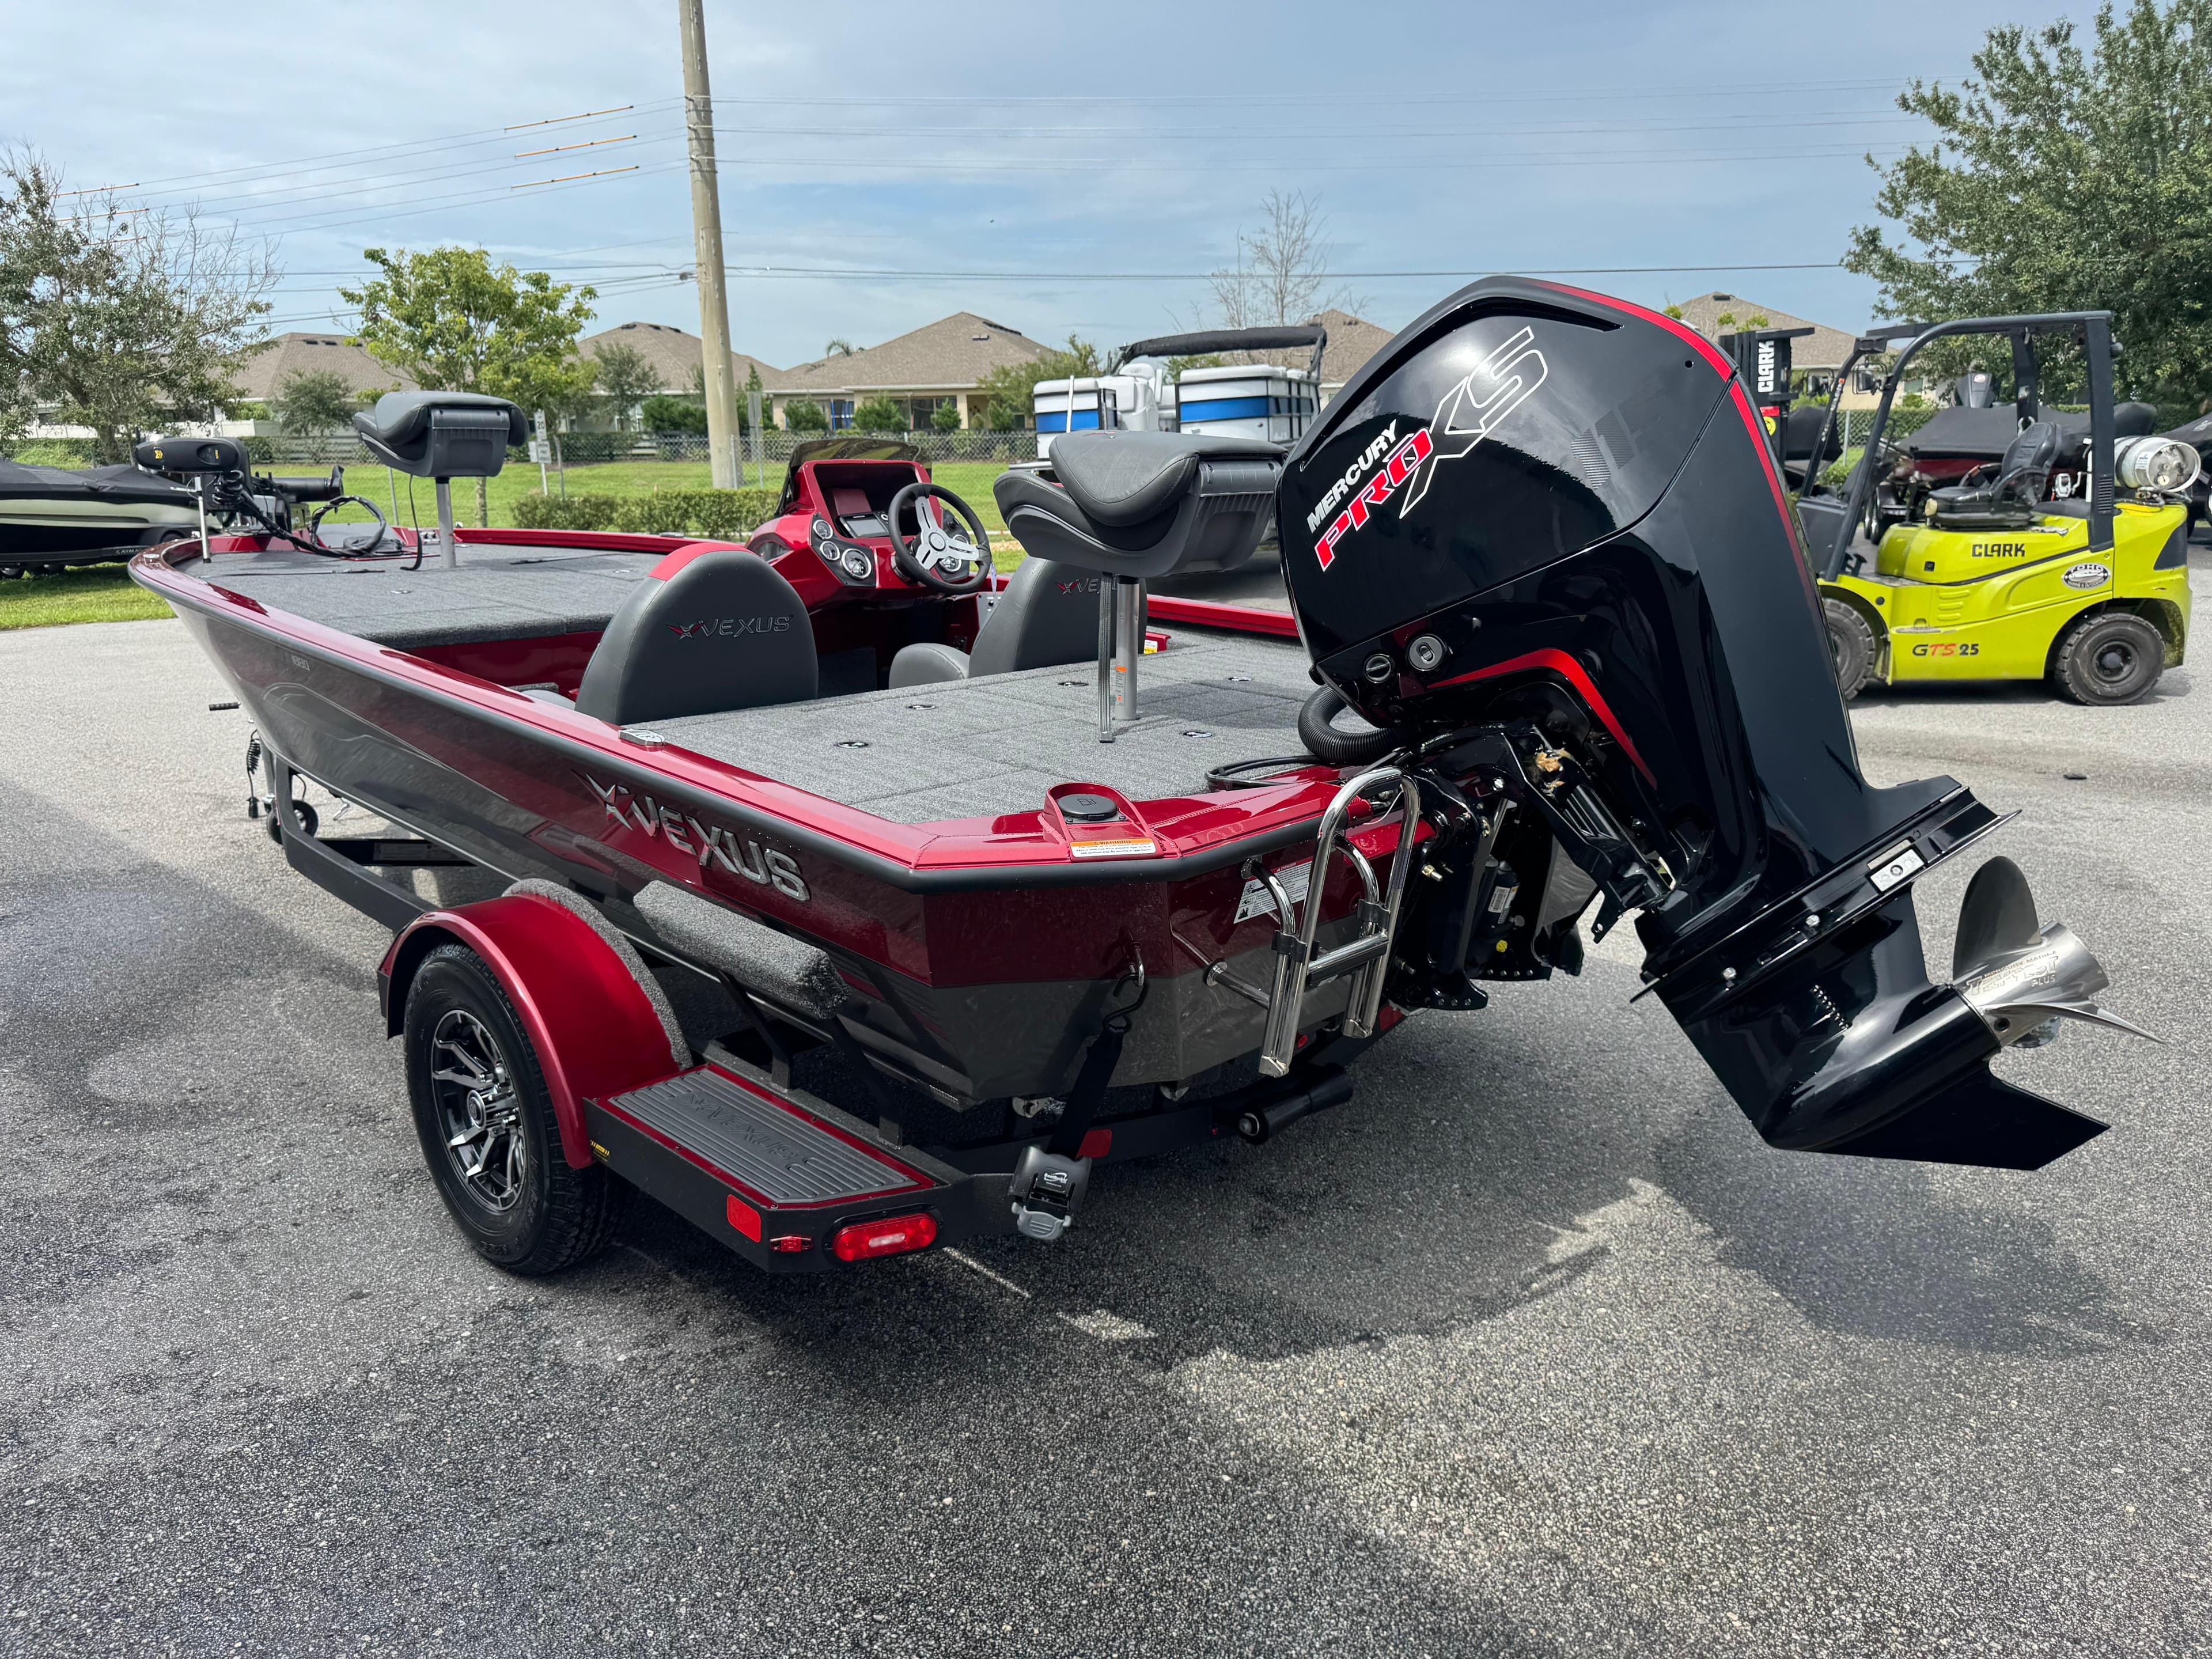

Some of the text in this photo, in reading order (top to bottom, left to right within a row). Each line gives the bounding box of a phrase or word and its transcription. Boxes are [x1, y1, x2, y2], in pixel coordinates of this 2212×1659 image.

[1758, 340, 1774, 393] CLARK
[1314, 325, 1548, 572] PRO XS
[1306, 419, 1397, 533] MERCURY
[1972, 543, 2025, 558] CLARK
[700, 616, 790, 638] VEXUS
[1912, 643, 1979, 657] GTS 25
[630, 796, 811, 902] VEXUS
[2031, 974, 2056, 987] PLUS
